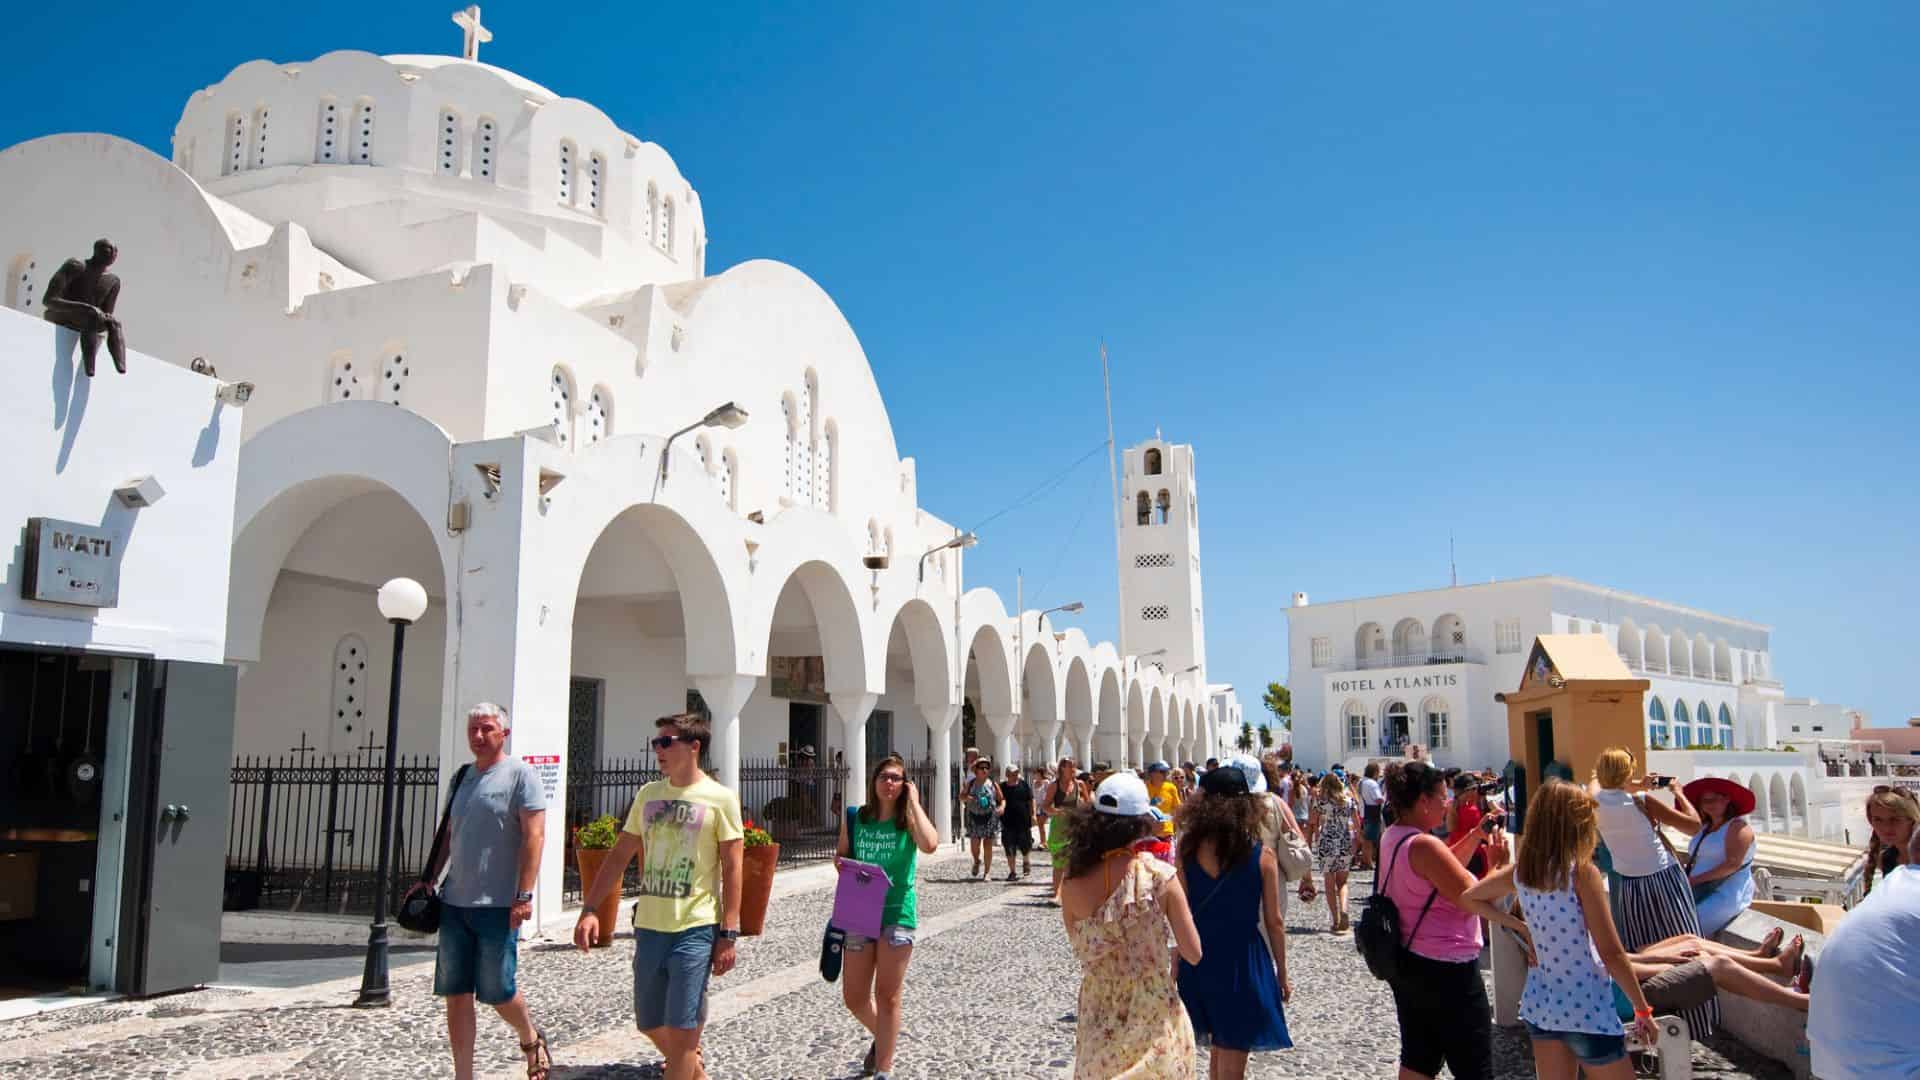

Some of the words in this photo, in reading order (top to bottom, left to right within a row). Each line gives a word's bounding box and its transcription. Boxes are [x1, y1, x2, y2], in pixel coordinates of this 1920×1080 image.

[53, 531, 112, 557] MATI
[1332, 679, 1376, 693] HOTEL
[1384, 674, 1457, 689] ATLANTIS
